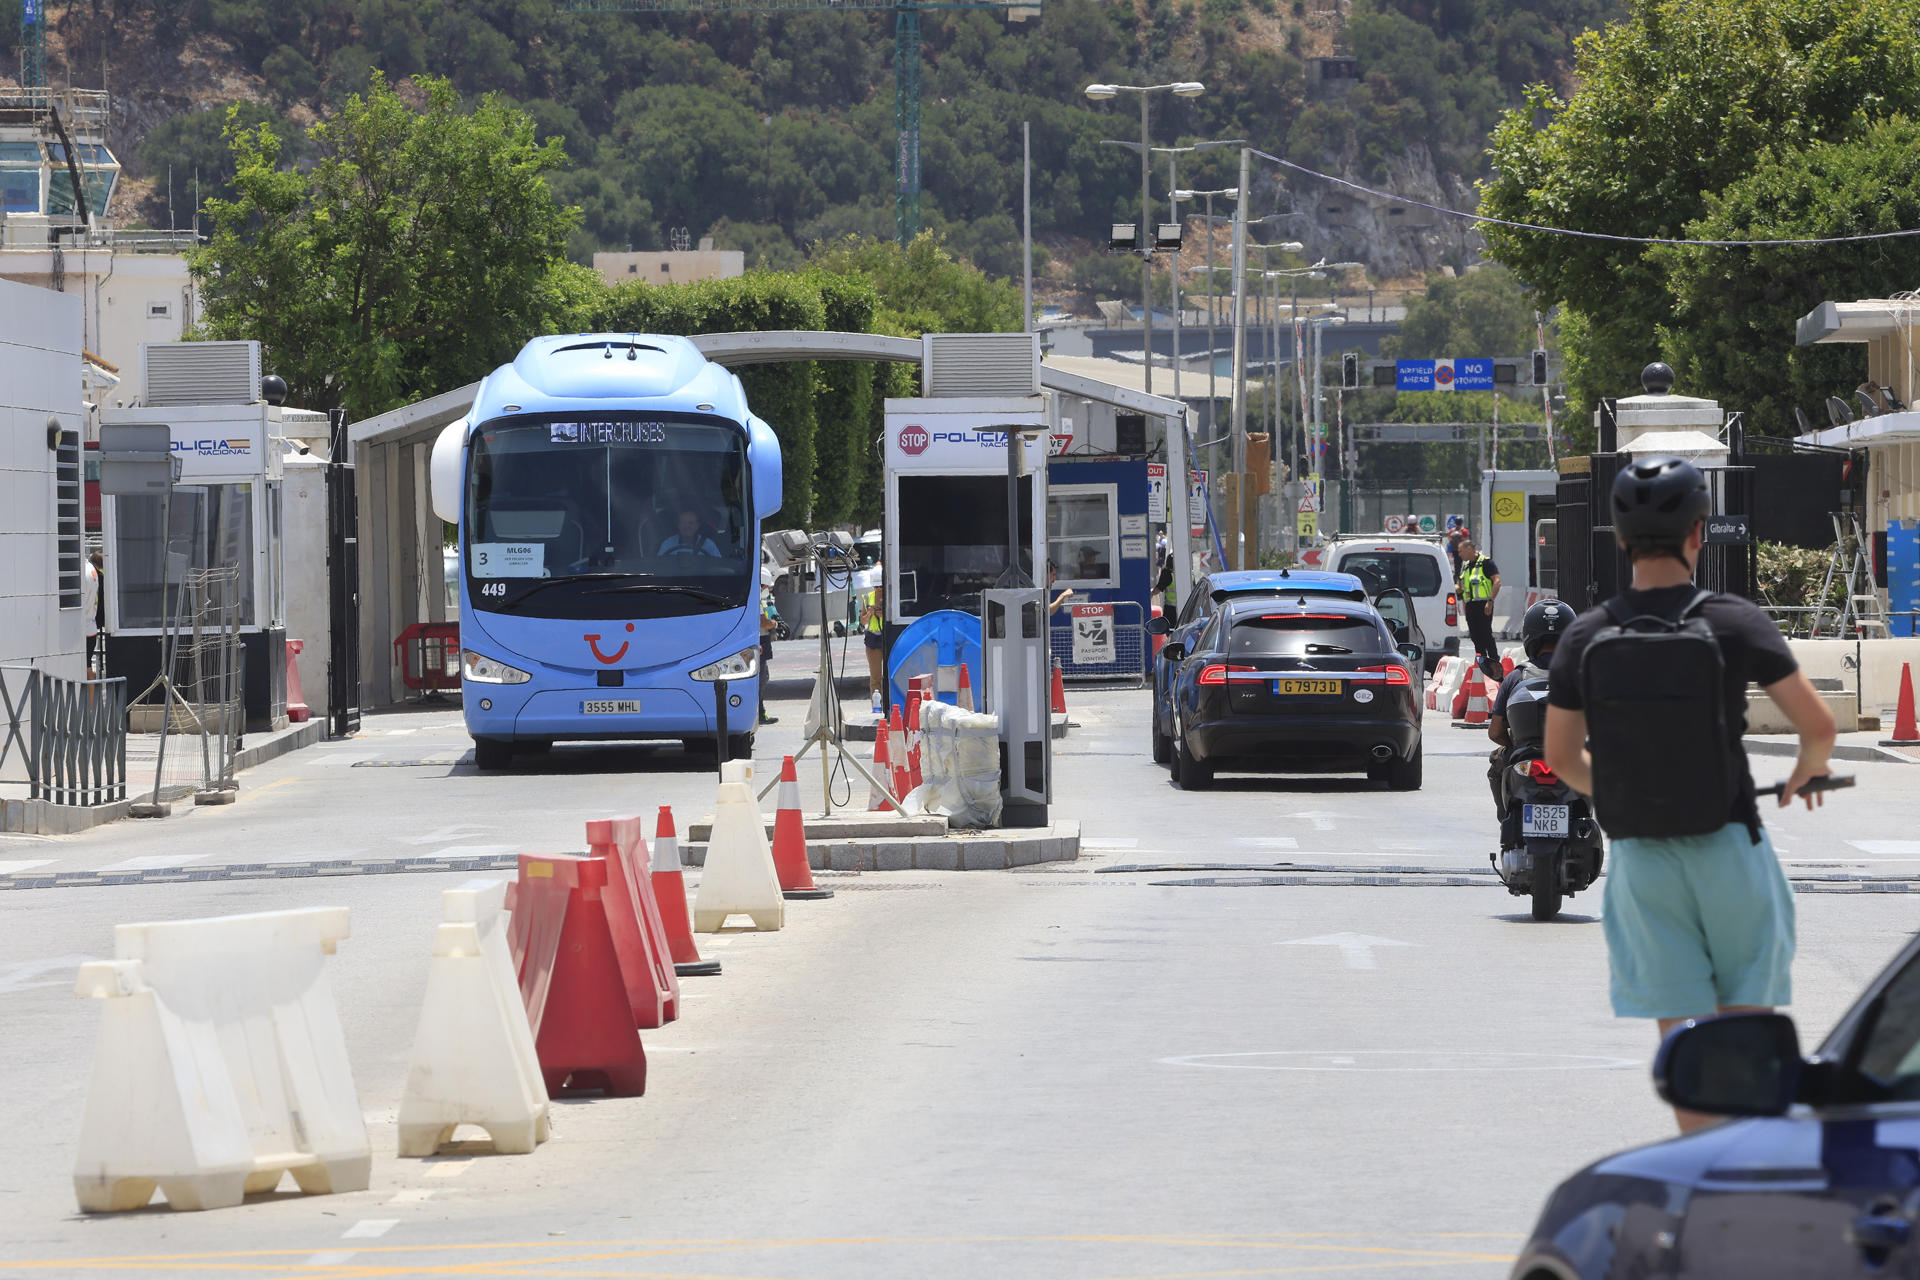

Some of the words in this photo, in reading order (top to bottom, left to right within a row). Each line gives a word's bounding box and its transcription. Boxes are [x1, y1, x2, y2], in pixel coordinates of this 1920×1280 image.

[1400, 367, 1433, 375] AIRFIELD
[1464, 364, 1483, 375] NO
[1403, 376, 1430, 384] AHEAD
[580, 422, 665, 443] INTERCRUISES
[901, 433, 927, 447] STOP
[1050, 439, 1063, 448] VE
[1148, 467, 1162, 475] OUT
[1710, 522, 1737, 534] Gibraltar
[479, 552, 489, 566] 3
[481, 583, 506, 596] 449
[1081, 606, 1104, 615] STOP
[1284, 681, 1292, 693] G
[1295, 681, 1326, 693] 7973
[1329, 681, 1336, 693] D
[1355, 691, 1372, 700] GBZ
[586, 701, 614, 713] 3555
[617, 701, 638, 712] MHL
[1534, 806, 1566, 819] 3525
[1534, 820, 1558, 831] NKB
